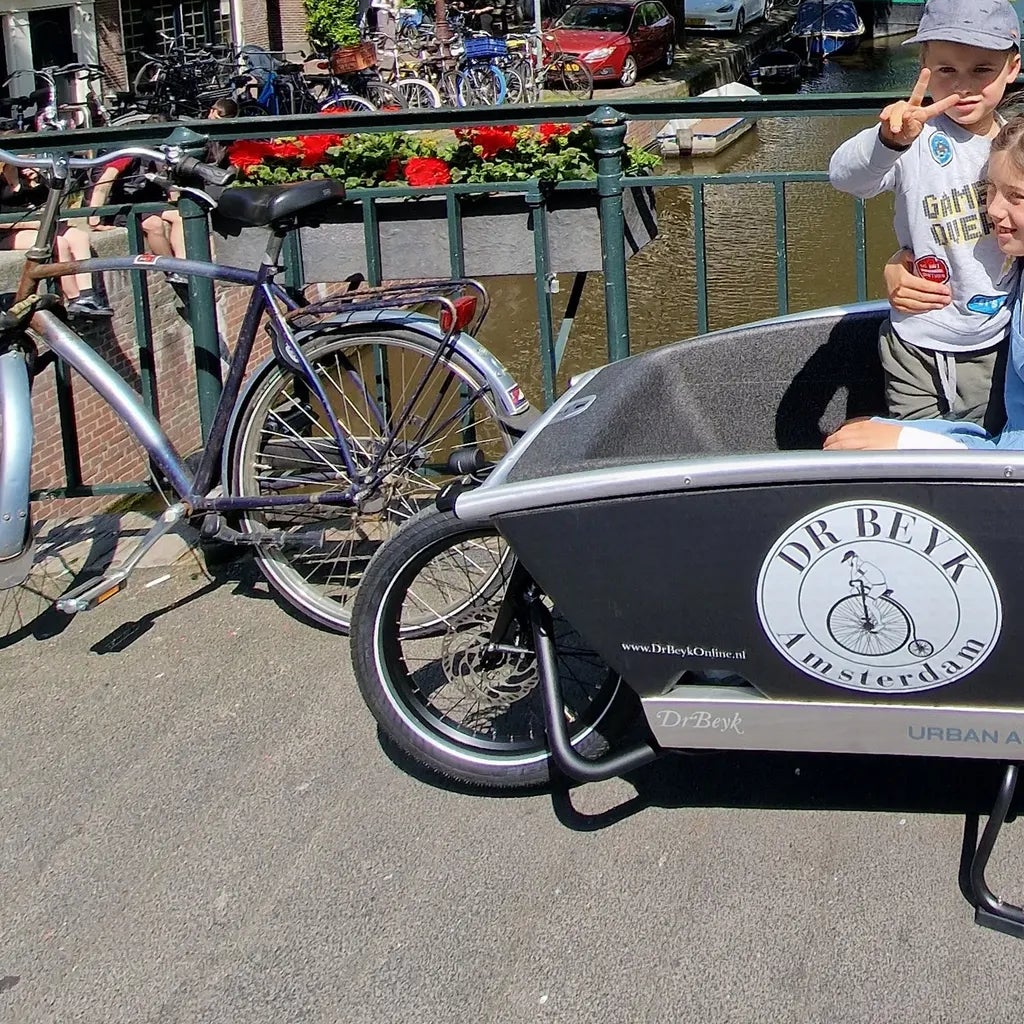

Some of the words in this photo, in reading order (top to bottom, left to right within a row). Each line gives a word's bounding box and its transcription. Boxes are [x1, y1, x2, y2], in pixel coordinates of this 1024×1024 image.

[776, 519, 842, 574] DR
[855, 507, 980, 585] BEYK
[621, 641, 746, 660] www.DrBeykOnline.nl
[777, 631, 986, 688] Amsterdam
[656, 710, 744, 734] DrBeyk
[908, 726, 998, 744] URBAN
